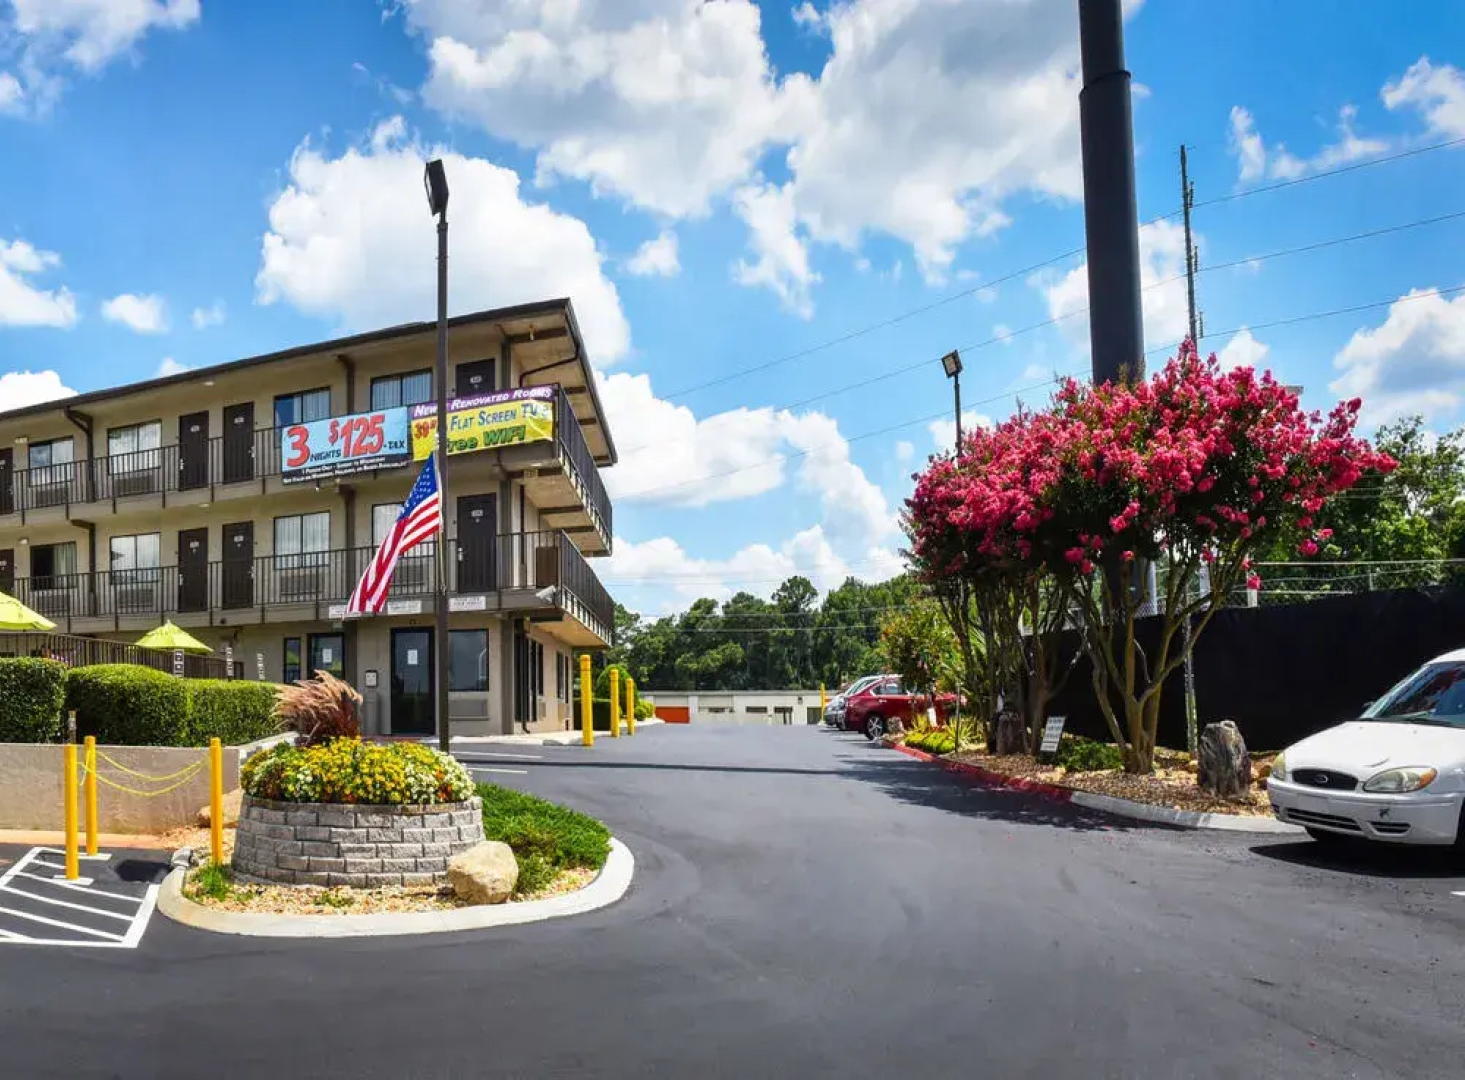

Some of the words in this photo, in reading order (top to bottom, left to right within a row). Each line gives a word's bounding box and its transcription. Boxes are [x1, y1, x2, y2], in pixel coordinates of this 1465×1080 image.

[450, 393, 509, 411] RENOVATED
[513, 386, 552, 400] ROOMS
[450, 415, 474, 432] FLAT
[478, 408, 518, 427] SCREEN
[286, 425, 310, 468] 3
[309, 449, 342, 463] NIGHTS
[328, 413, 385, 458] $125
